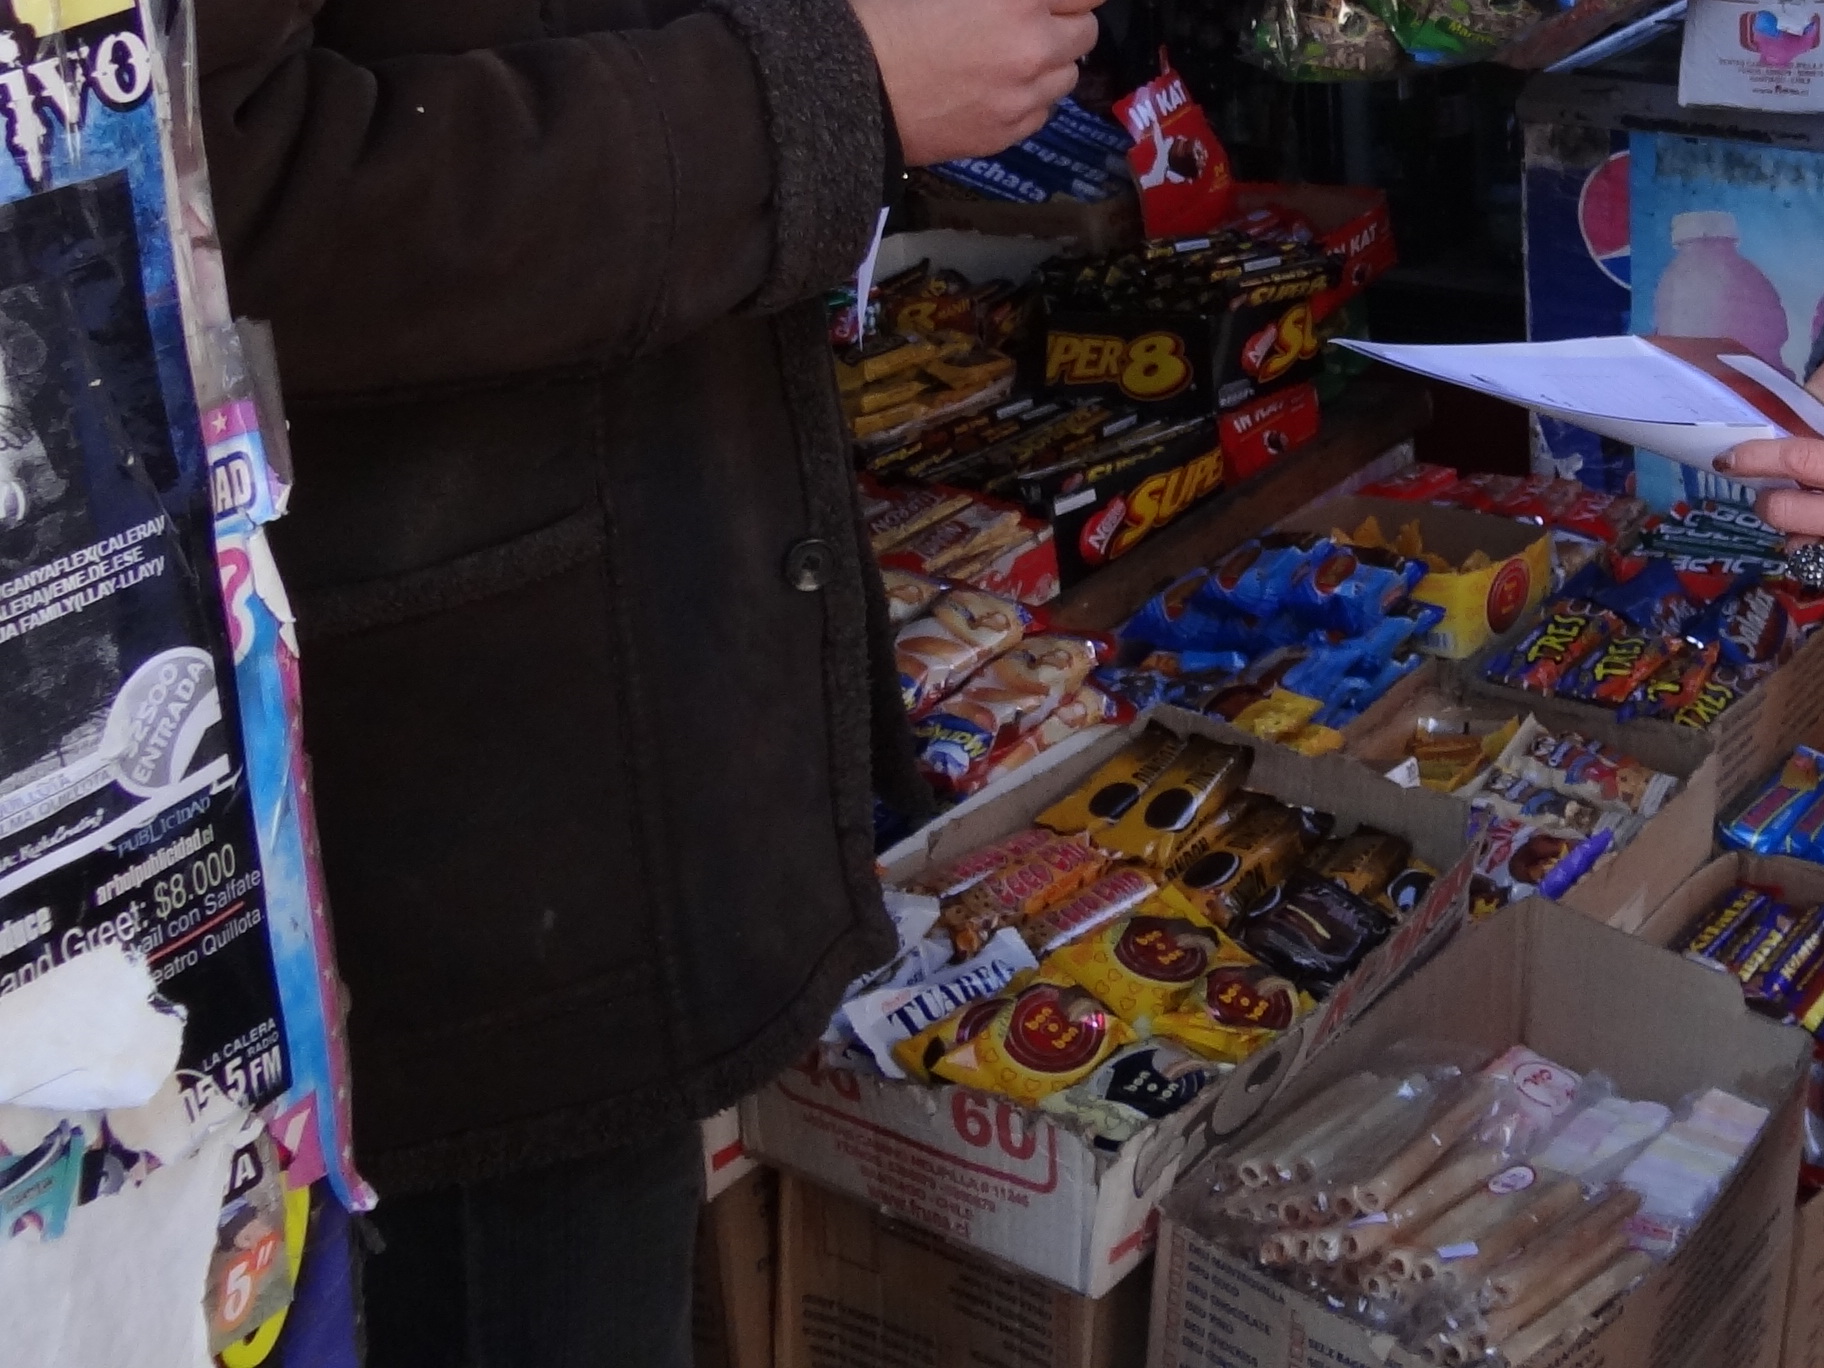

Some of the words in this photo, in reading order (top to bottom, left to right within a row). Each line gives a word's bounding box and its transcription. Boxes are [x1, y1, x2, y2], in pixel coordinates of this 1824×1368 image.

[1156, 79, 1188, 116] KAT
[1350, 222, 1378, 257] KAT
[132, 662, 206, 782] ENTRADA
[117, 795, 212, 858] PUBLICIDAD
[154, 842, 236, 920] $8.000
[170, 908, 201, 940] con
[204, 869, 262, 916] Salfate
[202, 907, 266, 957] Quillota.
[885, 958, 1015, 1030] TUAREG
[203, 1052, 220, 1072] LA
[223, 1018, 276, 1057] CALERA
[247, 1031, 279, 1057] RADIO
[1025, 1007, 1051, 1031] bon
[1052, 1025, 1079, 1049] bon
[249, 1044, 283, 1099] FM
[1124, 1070, 1149, 1093] bon
[951, 1089, 1036, 1160] 60
